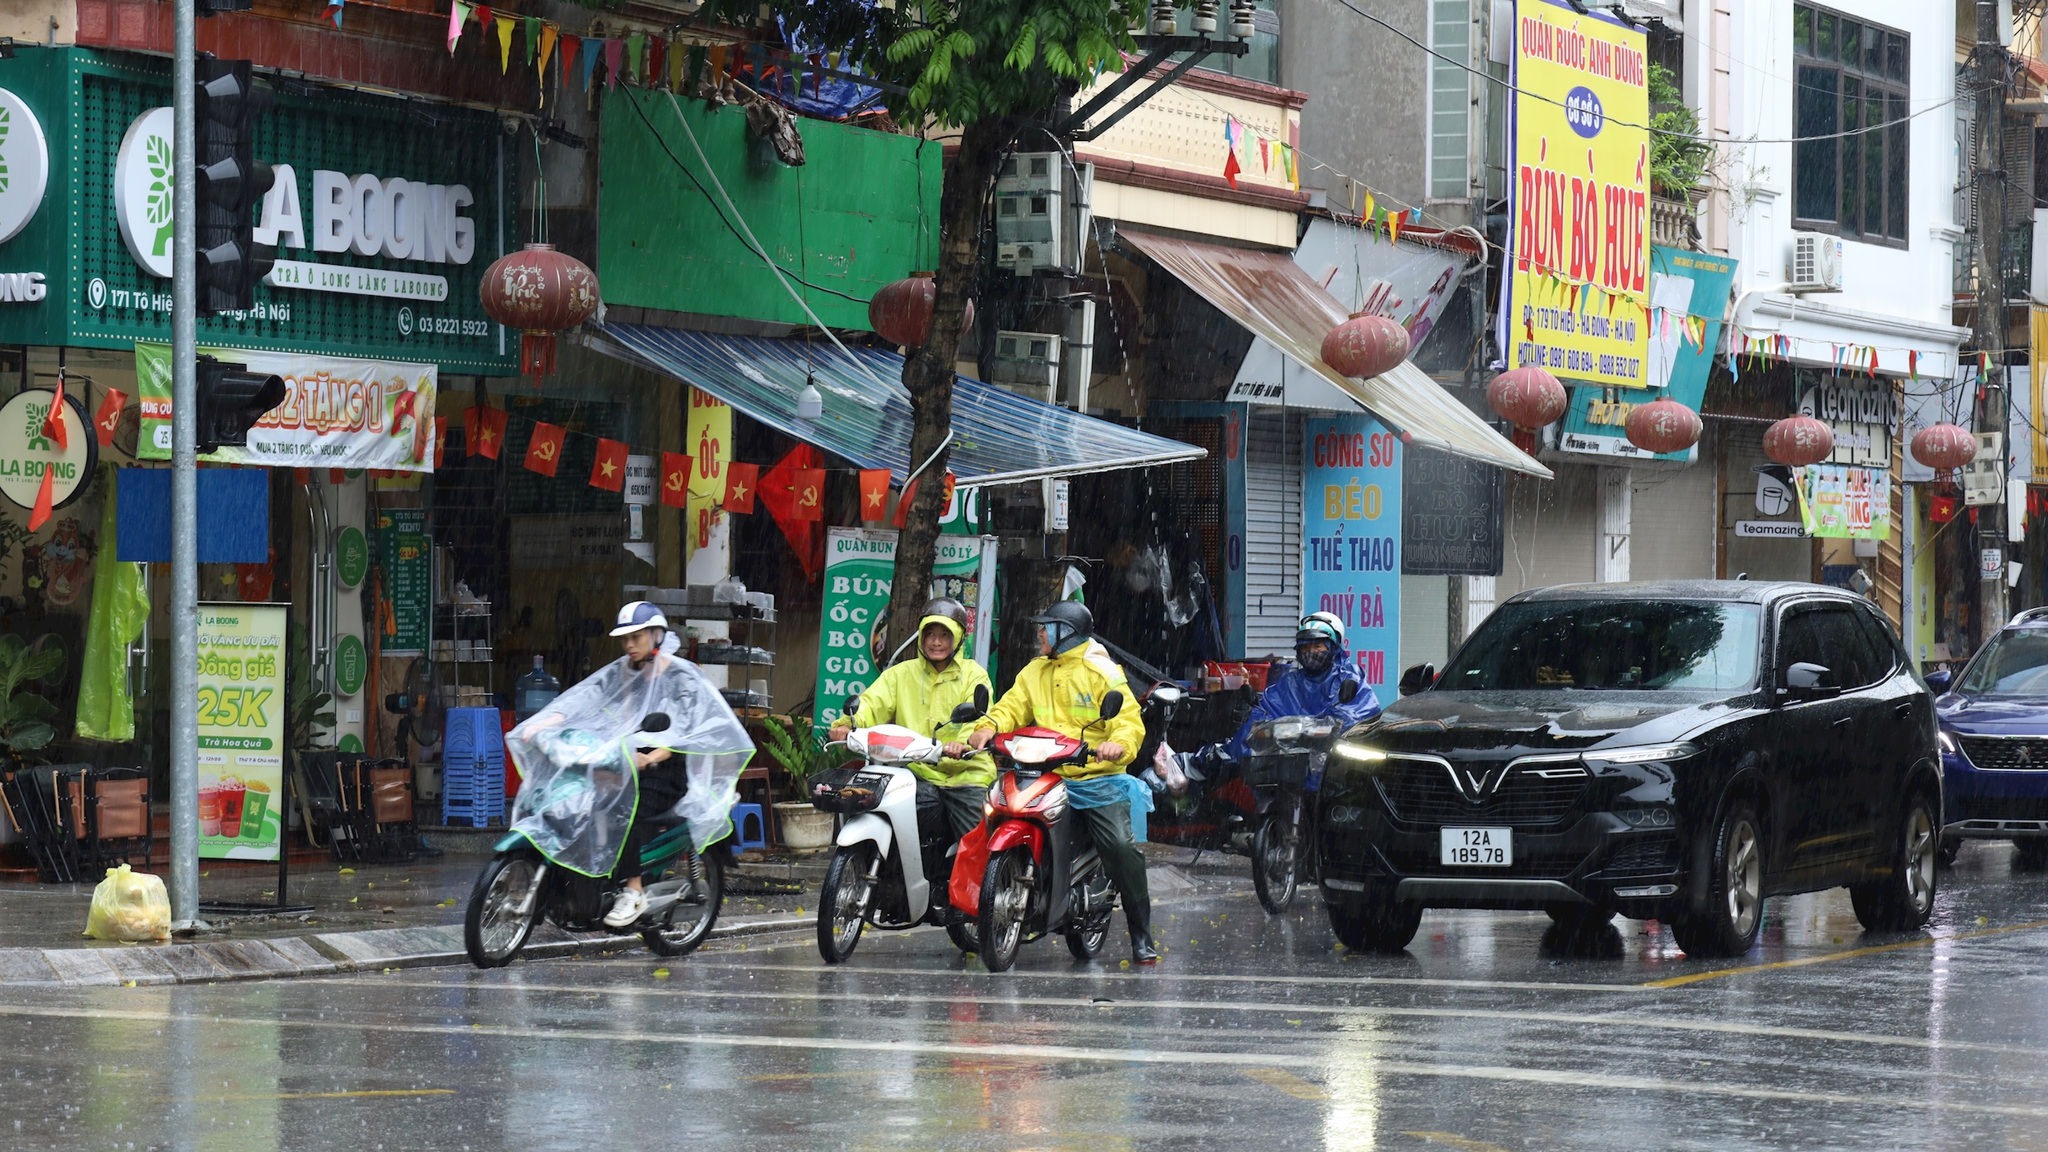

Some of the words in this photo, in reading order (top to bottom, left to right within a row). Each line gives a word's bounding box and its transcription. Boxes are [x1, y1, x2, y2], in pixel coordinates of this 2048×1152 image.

[1522, 14, 1553, 62] QUÁN
[1556, 20, 1586, 72] RUỐC
[1589, 38, 1612, 79] ANH
[1614, 40, 1644, 87] DŨNG
[1567, 95, 1580, 123] CƠ
[1581, 93, 1593, 128] SỞ
[1593, 103, 1600, 130] 3
[313, 169, 475, 265] BOONG
[1518, 137, 1566, 278] BÚN
[1570, 148, 1598, 283] BÒ
[1604, 143, 1646, 293] HUẾ
[277, 266, 300, 283] TRÀ
[308, 267, 314, 285] Ô
[322, 272, 351, 288] LONG
[358, 273, 387, 292] LÀNG
[394, 279, 444, 297] LABOONG
[111, 289, 130, 308] 171
[133, 290, 149, 310] Tô
[152, 292, 173, 317] Hiệ
[269, 303, 291, 325] Nội
[420, 317, 433, 333] 03
[435, 318, 460, 334] 8221
[463, 320, 488, 336] 5922
[1537, 307, 1549, 329] 179
[1551, 305, 1559, 330] TÔ
[1615, 316, 1624, 341] HÀ
[1625, 317, 1636, 346] NỘI
[1518, 342, 1548, 367] HOTLINE:
[1549, 346, 1565, 369] 0981
[282, 376, 300, 424] 2
[302, 371, 365, 431] TẶNG
[368, 382, 382, 430] 1
[1821, 378, 1900, 436] teamazing
[699, 424, 720, 479] ỐC
[1314, 426, 1363, 468] CÔNG
[0, 459, 21, 476] LA
[1323, 477, 1382, 520] BÉO
[1411, 503, 1490, 542] HUẾ
[1743, 522, 1805, 537] teamazing
[837, 537, 868, 553] QUÁN
[941, 543, 956, 558] CÔ
[958, 544, 972, 559] LÝ
[1311, 523, 1344, 571] THỂ
[1349, 537, 1394, 572] THAO
[832, 573, 892, 597] BÚN
[205, 617, 215, 625] LA
[216, 617, 239, 626] BOONG
[829, 599, 869, 624] ỐC
[1360, 586, 1385, 628] BÀ
[828, 629, 866, 649] BÒ
[245, 653, 276, 681] giá
[825, 655, 870, 675] GIÒ
[198, 687, 272, 728] 25K
[204, 738, 220, 747] Trà
[222, 738, 241, 748] Hoa
[243, 738, 262, 748] Quả
[1463, 830, 1491, 846] 12A
[1451, 847, 1504, 864] 189.78
